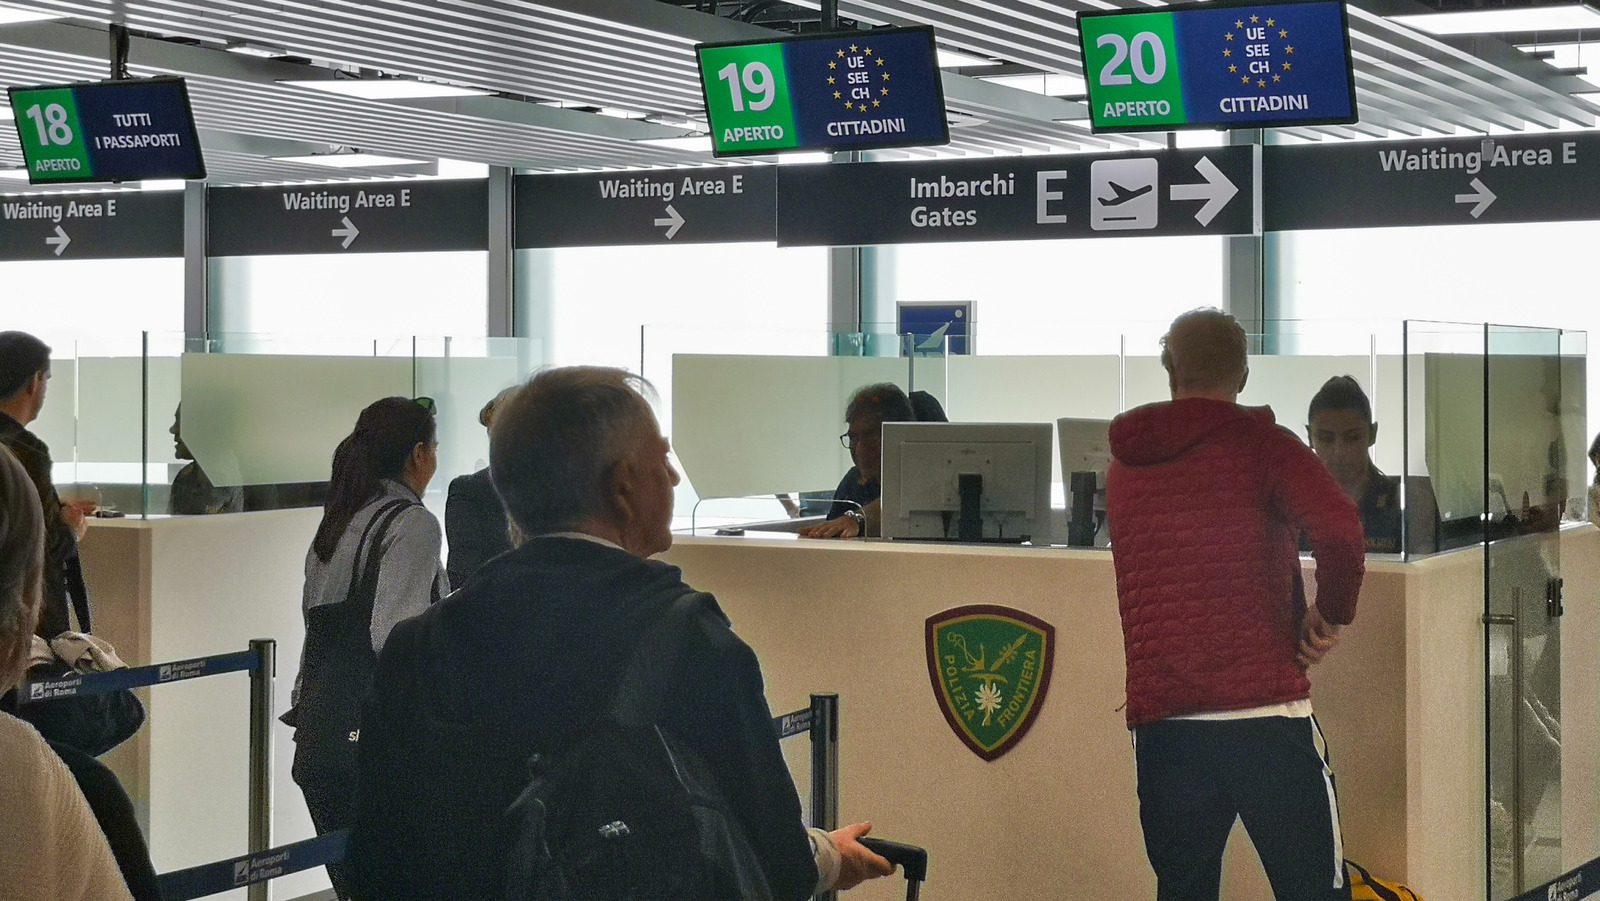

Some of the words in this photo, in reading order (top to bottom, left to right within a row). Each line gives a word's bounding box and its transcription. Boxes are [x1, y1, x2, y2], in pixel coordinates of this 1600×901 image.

[1246, 27, 1266, 41] UE
[1096, 31, 1168, 87] 20
[1245, 44, 1271, 57] SEE
[847, 56, 865, 69] UE
[1249, 60, 1270, 74] CH
[718, 61, 776, 113] 19
[847, 72, 870, 85] SEE
[851, 87, 870, 100] CH
[1102, 100, 1171, 118] APERTO
[1219, 94, 1309, 114] CITTADINI
[26, 103, 73, 146] 18
[113, 113, 152, 128] TUTTI
[826, 118, 906, 137] CITTADINI
[96, 136, 101, 149] I
[103, 134, 181, 149] PASSAPORTI
[723, 125, 784, 143] APERTO
[35, 158, 81, 173] APERTO
[1379, 147, 1481, 174] Waiting
[1490, 145, 1552, 167] Area
[1562, 142, 1577, 164] E
[599, 178, 674, 201] Waiting
[680, 176, 726, 194] Area
[732, 175, 743, 193] E
[910, 173, 1015, 199] Imbarchi
[283, 192, 350, 213] Waiting
[355, 190, 396, 207] Area
[401, 189, 411, 206] E
[1036, 170, 1068, 225] E
[3, 202, 62, 222] Waiting
[66, 201, 103, 217] Area
[107, 200, 116, 216] E
[910, 206, 977, 228] Gates
[171, 660, 206, 671] Aeroporti
[180, 669, 201, 679] Roma
[44, 678, 82, 689] Aeroporti
[44, 689, 53, 698] di
[53, 687, 77, 696] Roma
[945, 655, 975, 721] POLIZIA
[997, 650, 1036, 729] FRONTIERA
[251, 850, 290, 869] Aeroporti
[260, 866, 283, 879] Roma
